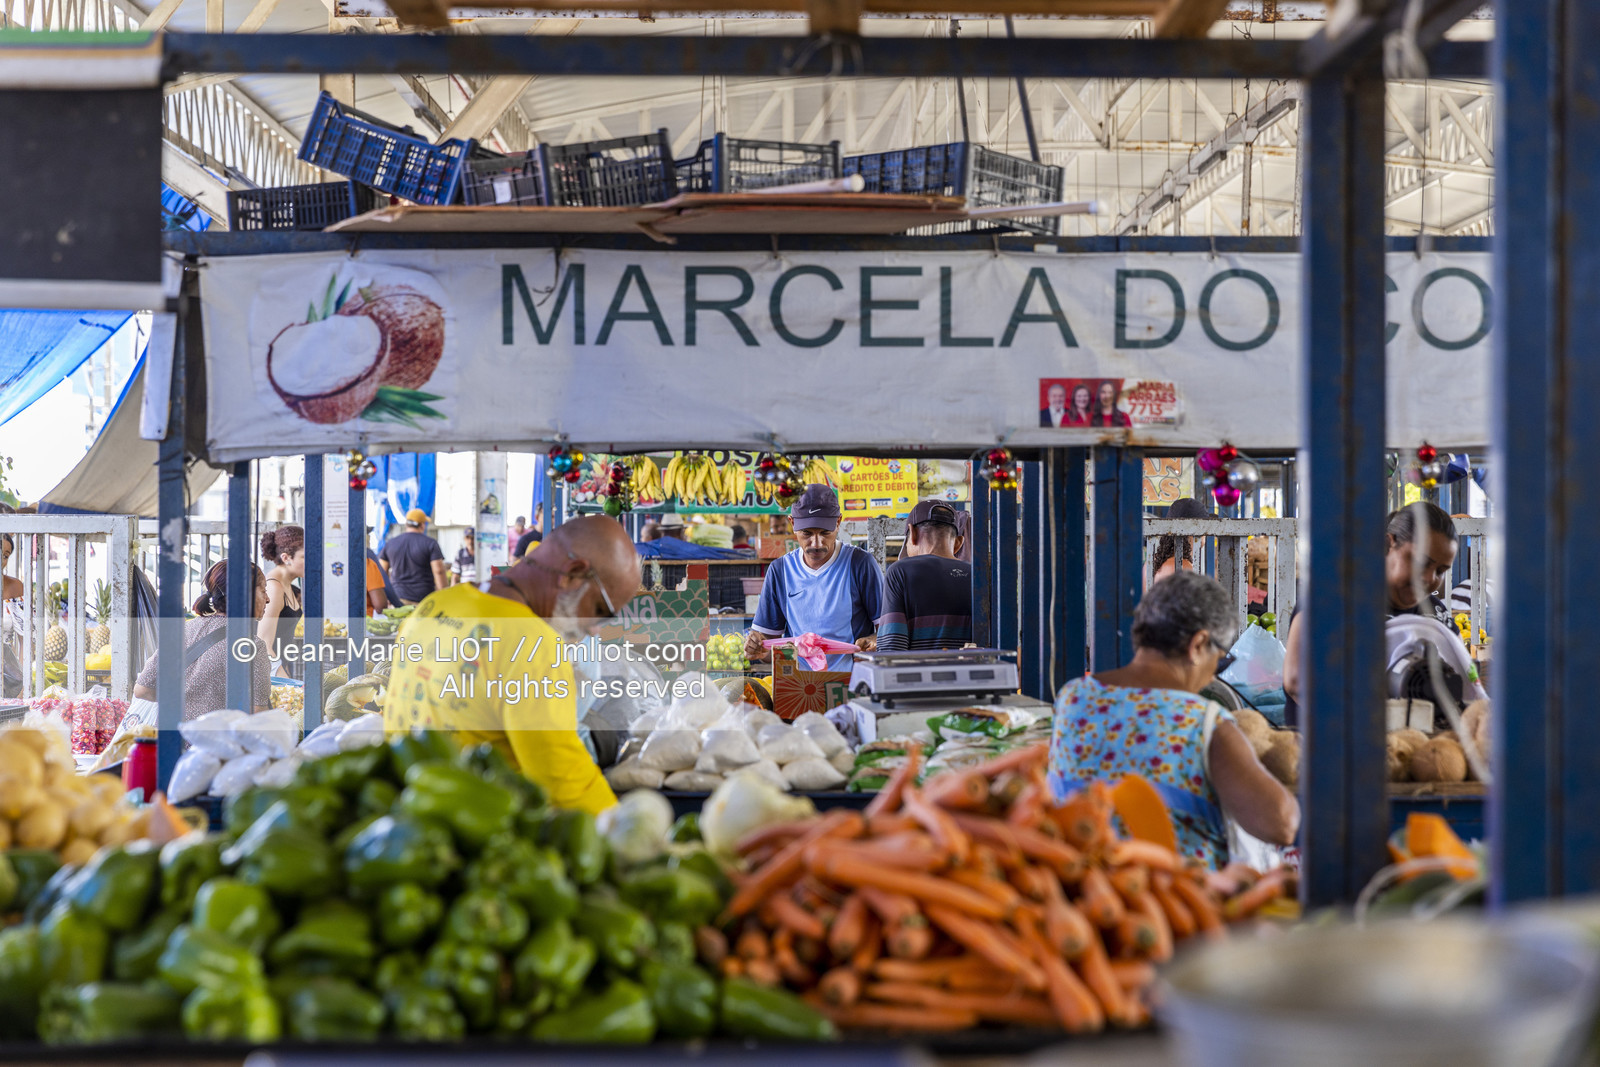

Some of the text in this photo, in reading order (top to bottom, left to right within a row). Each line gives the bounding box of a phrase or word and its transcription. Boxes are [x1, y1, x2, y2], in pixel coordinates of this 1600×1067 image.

[501, 263, 1495, 352] MARCELA DO O
[1128, 402, 1163, 416] 7713
[855, 456, 899, 466] TODO
[849, 471, 904, 482] CARTÕES DE
[839, 483, 875, 492] RÉDITO
[877, 483, 884, 491] E
